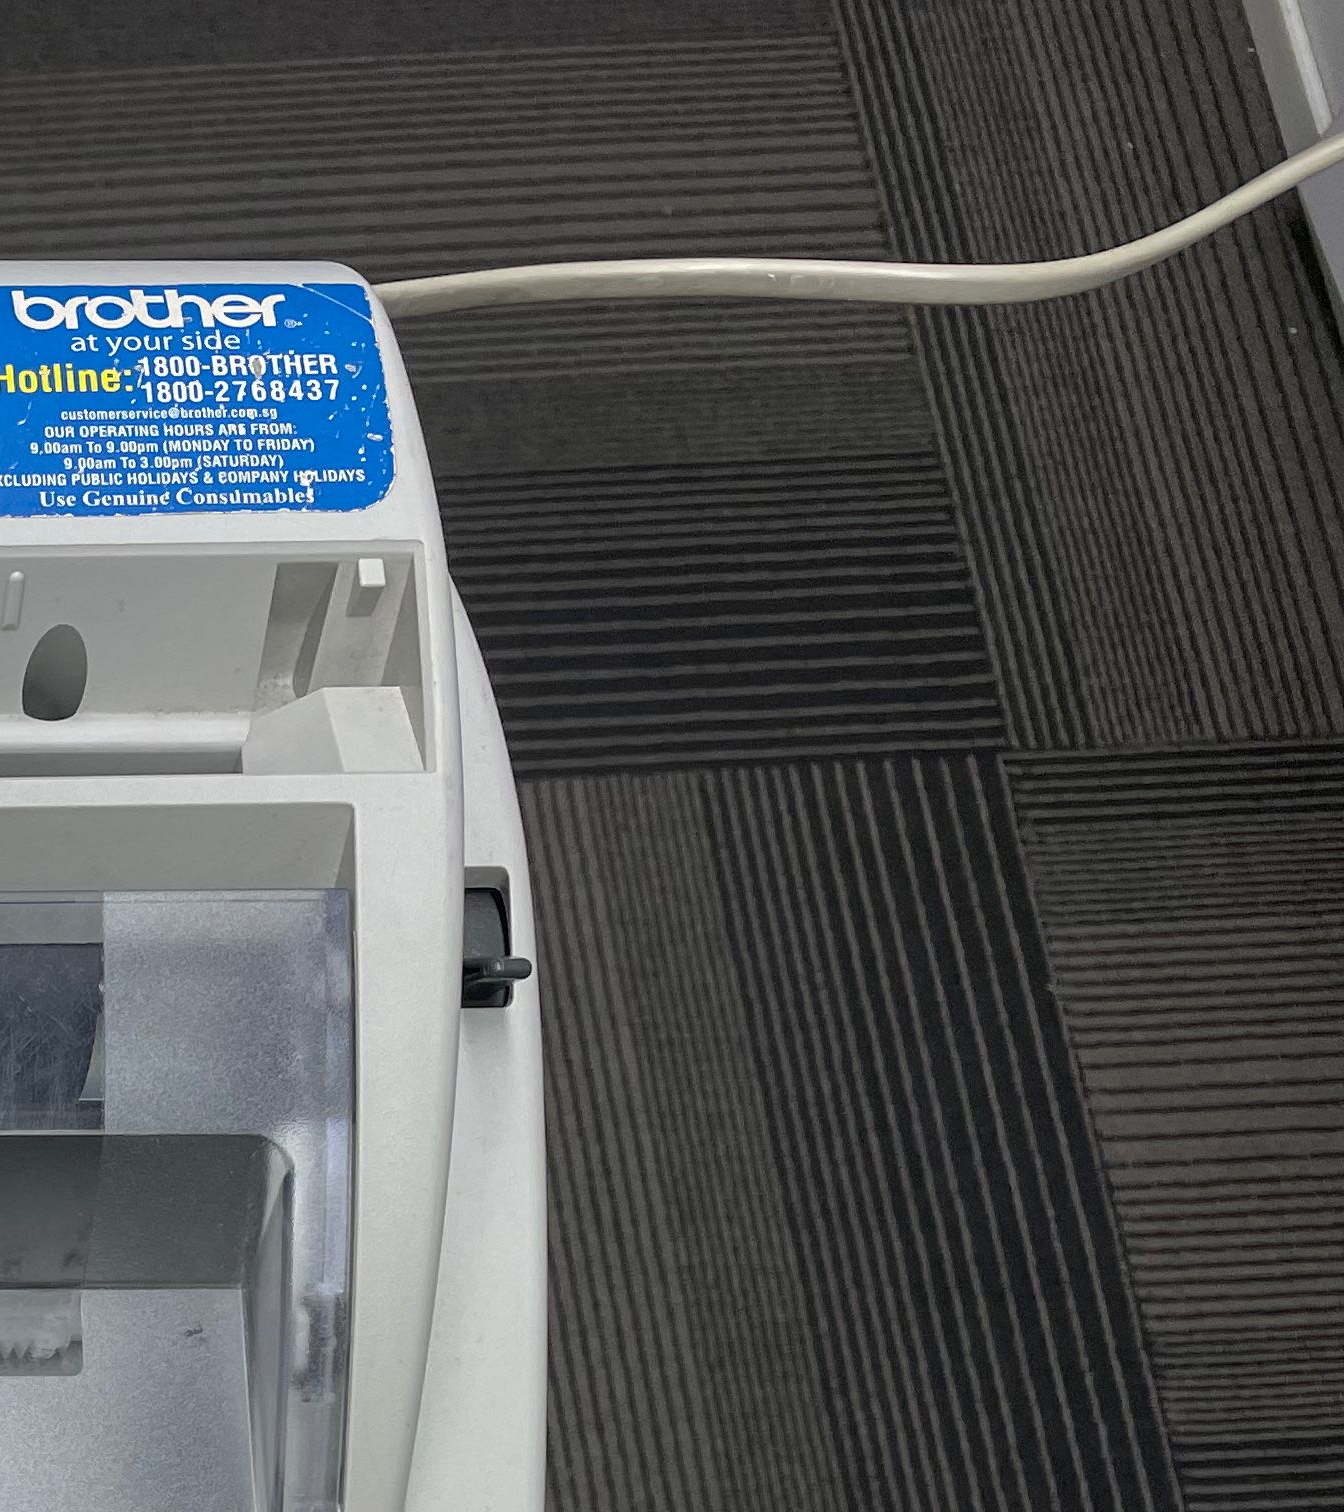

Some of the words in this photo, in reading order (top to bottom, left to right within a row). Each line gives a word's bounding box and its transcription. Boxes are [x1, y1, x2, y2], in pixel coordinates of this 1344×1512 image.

[11, 289, 285, 329] brother
[71, 336, 98, 352] at
[106, 335, 172, 356] your
[182, 331, 241, 350] side
[140, 354, 338, 377] 1800-BROTHER
[141, 379, 339, 402] 1800-2768437
[44, 426, 75, 438] OUR
[80, 425, 159, 437] OPERATING
[163, 424, 213, 437] HOURS
[251, 423, 297, 435] FROM:
[86, 441, 102, 453] To
[106, 441, 158, 454] 9.00pm
[163, 440, 229, 452] (MONDAY
[234, 439, 253, 451] TO
[257, 438, 314, 452] FRIDAY)
[64, 458, 116, 470] 9.00am
[120, 457, 136, 469] To
[140, 456, 193, 470] 3.00pm
[197, 455, 284, 468] (SATURDAY)
[72, 473, 122, 486] PUBLIC
[127, 471, 199, 485] HOLIDAYS
[204, 472, 213, 484] &
[218, 471, 288, 484] COMPANY
[294, 469, 365, 483] HOLIDAYS
[39, 491, 76, 507] Use
[82, 490, 170, 507] Genuine
